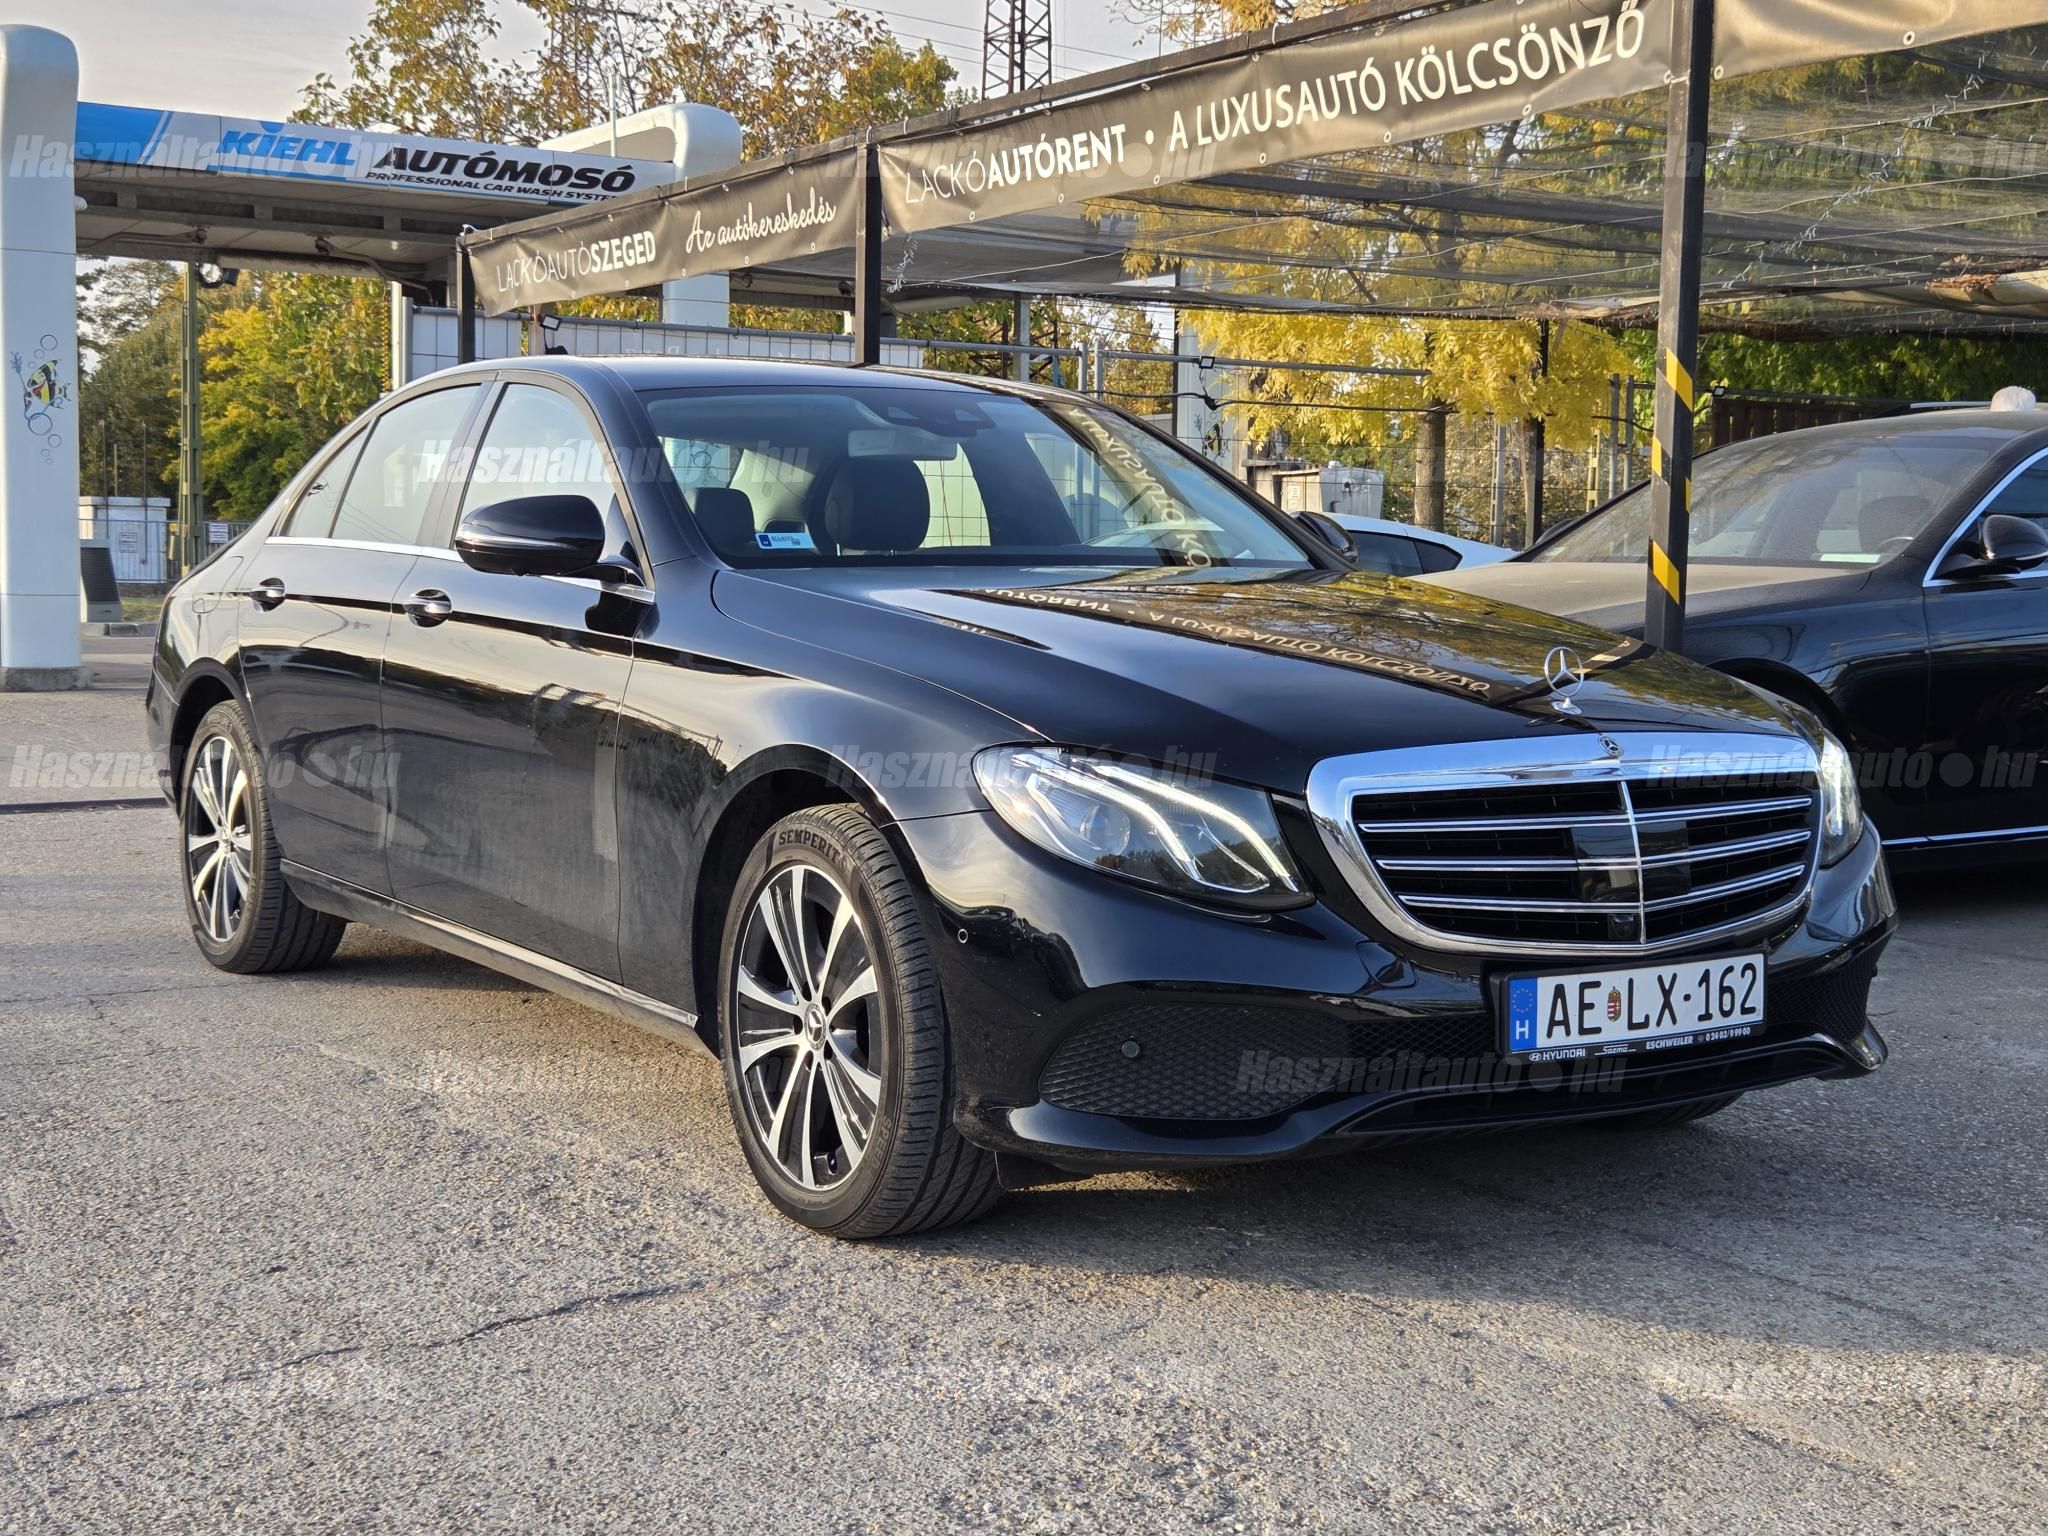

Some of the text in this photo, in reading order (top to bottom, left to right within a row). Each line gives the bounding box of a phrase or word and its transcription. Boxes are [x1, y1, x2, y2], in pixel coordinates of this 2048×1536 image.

[904, 0, 1644, 204] LACKÓAUTÓRENT A LUXUSAUTÓ KÖLCSÖNZŐ
[216, 122, 356, 166] KIEHL
[365, 172, 617, 201] PROFESSIONAL CAR WASH SYSTE
[373, 147, 636, 193] AUTÓMOSÓ
[496, 186, 837, 293] LACKÓAUTÓSZEGED Az autókereskedés
[778, 829, 842, 865] SEMPERIT
[1515, 1019, 1530, 1041] H
[1546, 981, 1602, 1039] AE
[1543, 1047, 1586, 1061] HYUNDAI
[1646, 1035, 1694, 1050] ESCHWEILER
